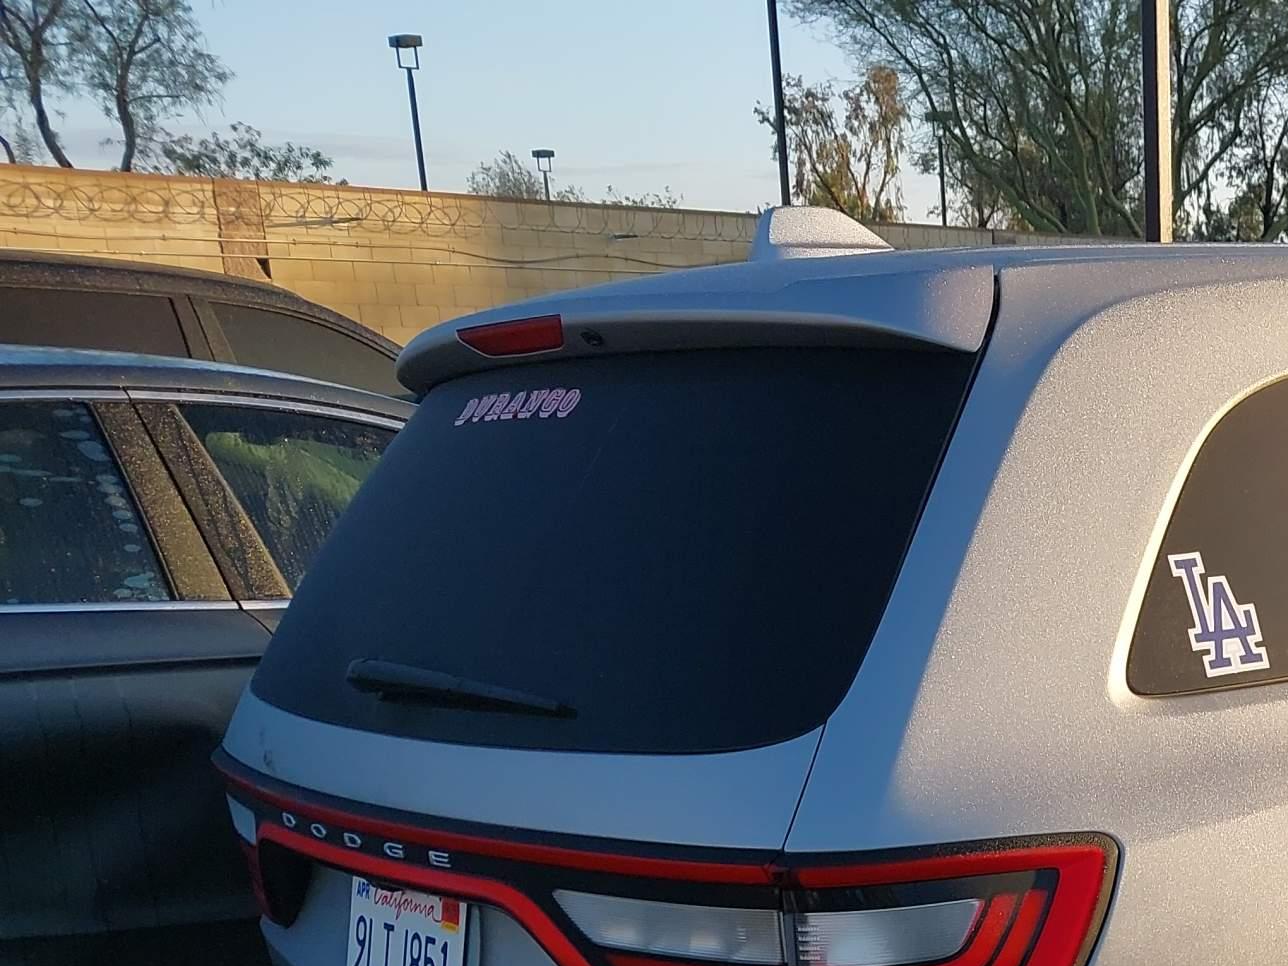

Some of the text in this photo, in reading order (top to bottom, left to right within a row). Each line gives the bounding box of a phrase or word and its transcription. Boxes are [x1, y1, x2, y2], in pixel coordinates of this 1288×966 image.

[454, 388, 582, 426] DURANGO
[1167, 552, 1270, 678] LA
[282, 812, 451, 868] DODGE
[356, 880, 370, 899] APR
[373, 887, 442, 922] California
